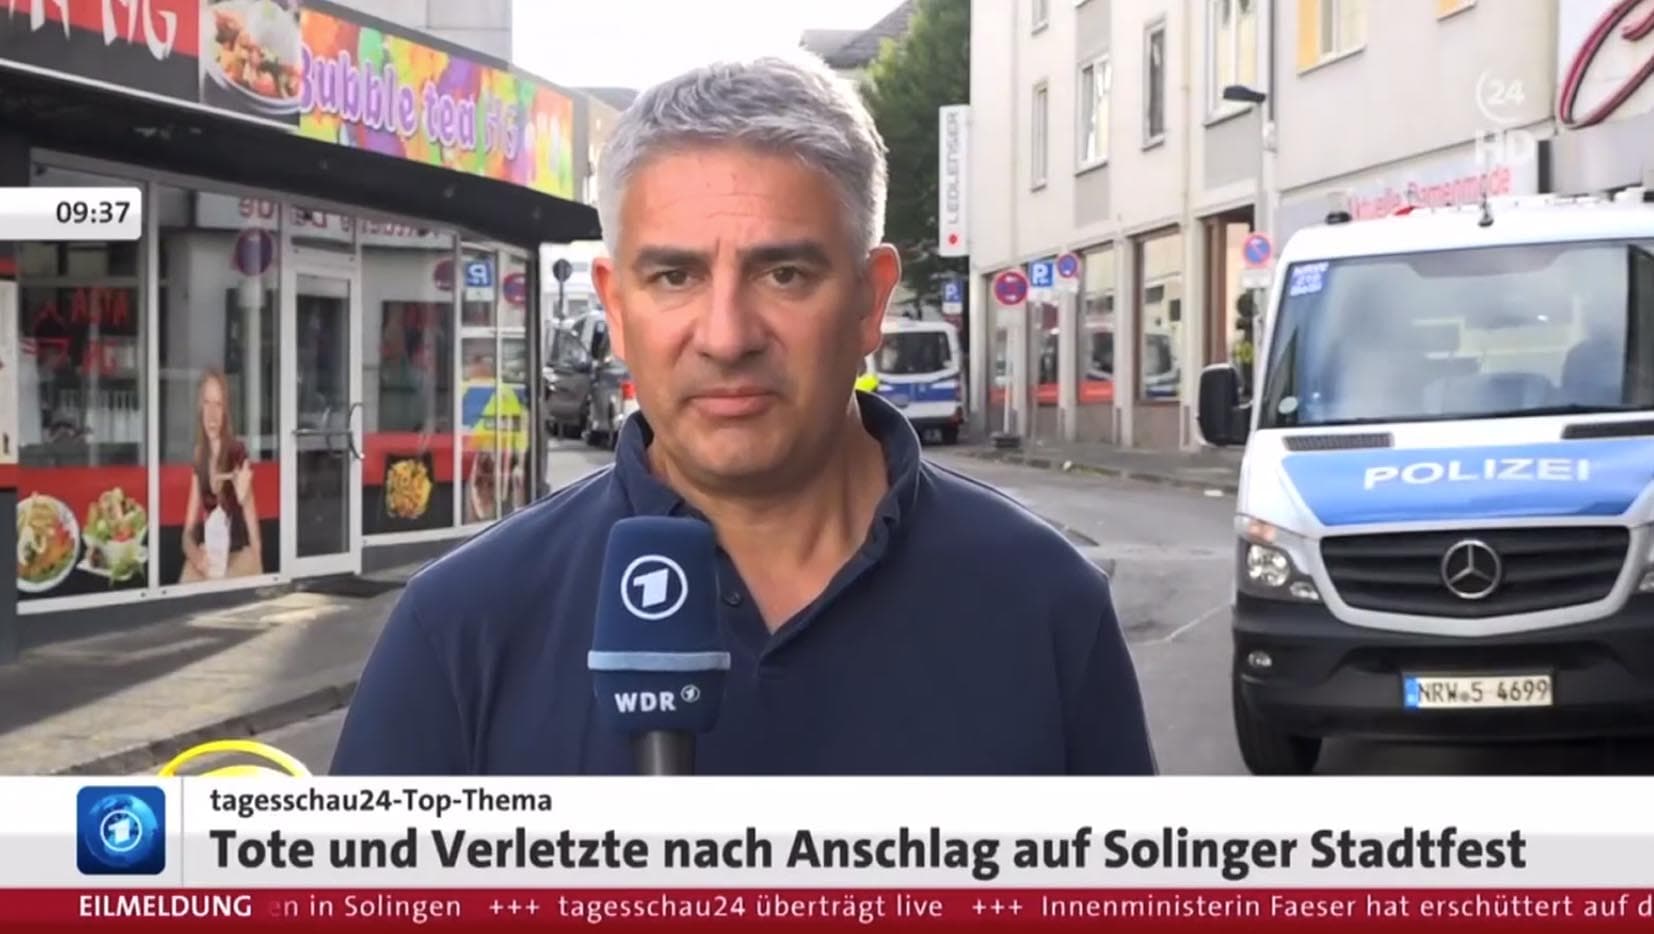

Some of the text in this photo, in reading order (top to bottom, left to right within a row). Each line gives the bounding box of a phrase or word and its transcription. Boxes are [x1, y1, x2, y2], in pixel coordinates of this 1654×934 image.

[300, 42, 417, 138] Bubble
[422, 80, 476, 150] tea
[946, 111, 960, 225] LEDLENSER
[1364, 457, 1591, 491] POLIZEI
[614, 692, 676, 713] WDR
[1497, 679, 1548, 702] 4699
